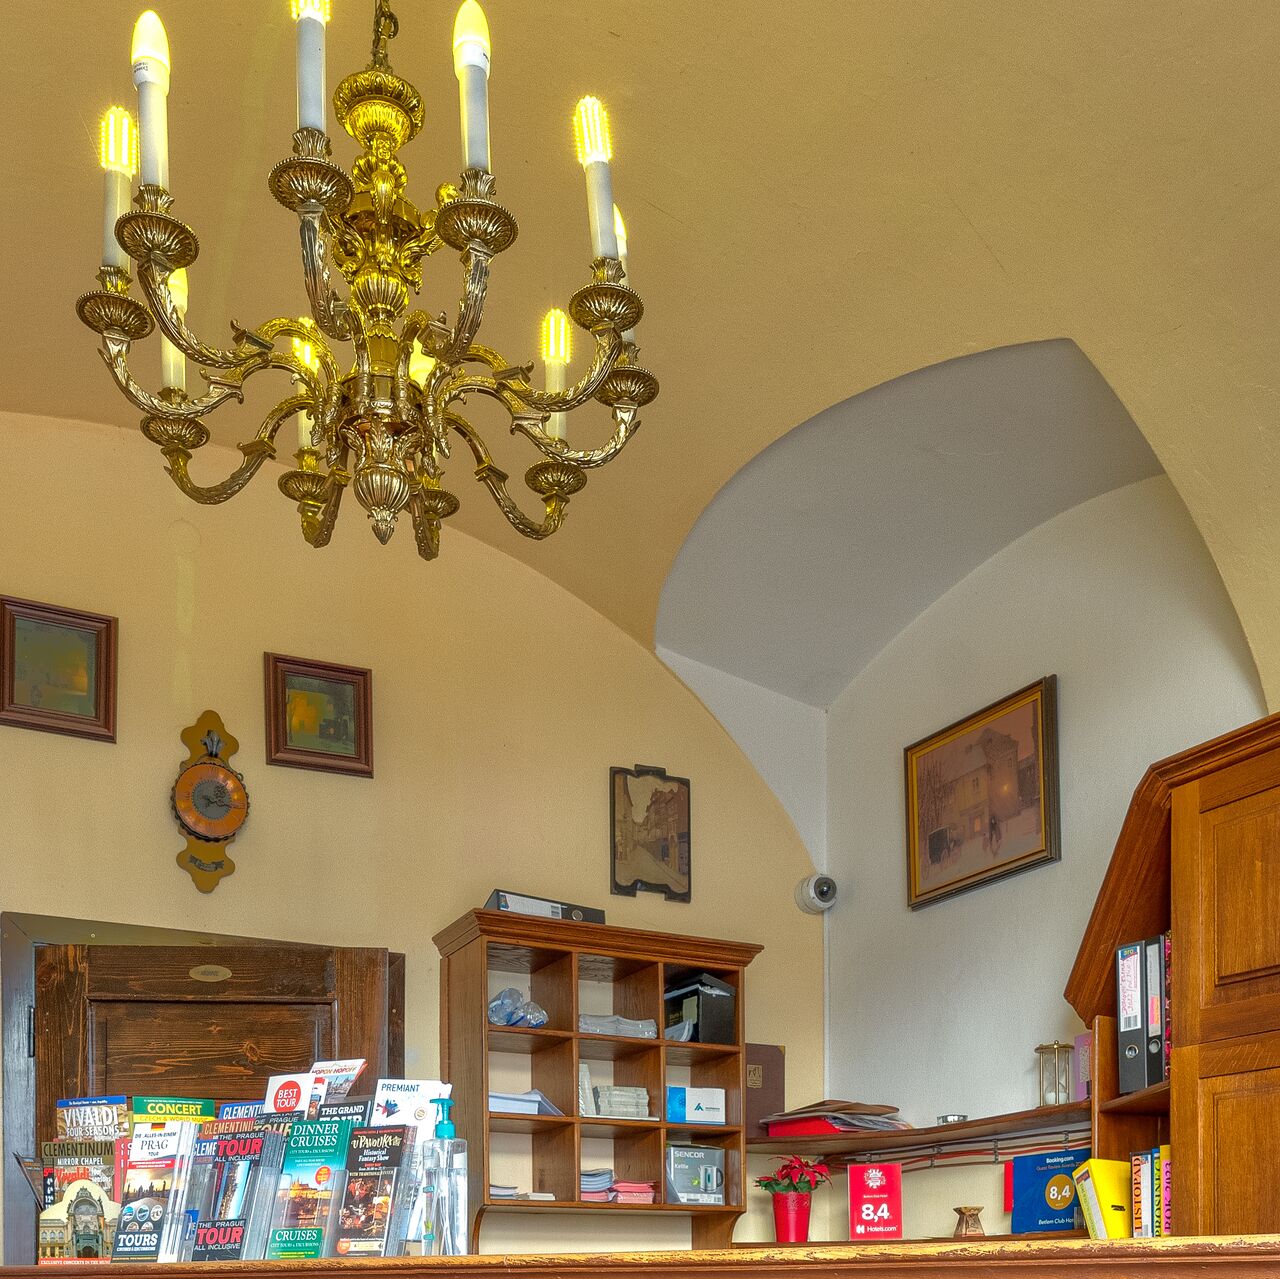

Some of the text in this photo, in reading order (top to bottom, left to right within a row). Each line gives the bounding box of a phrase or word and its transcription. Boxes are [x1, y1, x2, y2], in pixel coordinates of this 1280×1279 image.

[278, 1089, 297, 1098] BEST
[381, 1083, 420, 1092] PREMIANT
[147, 1103, 202, 1114] CONCERT
[276, 1098, 297, 1108] TOUR
[339, 1105, 364, 1114] GRAND
[64, 1107, 118, 1127] VIVALDI
[66, 1125, 119, 1137] FOUR SEASONS
[294, 1124, 339, 1136] DINNER
[141, 1140, 168, 1150] PRAG
[217, 1138, 263, 1156] TOUR
[290, 1135, 337, 1147] CRUISES
[44, 1143, 114, 1157] CLEMENTINUM
[674, 1150, 704, 1159] SENCOR
[1046, 1156, 1074, 1164] Booking.com
[1050, 1185, 1071, 1200] 8,4
[1134, 1158, 1142, 1230] LISTOPAD
[861, 1203, 889, 1222] 8,4
[118, 1233, 158, 1246] TOURS
[197, 1227, 243, 1245] TOUR
[275, 1230, 317, 1241] CRUISES
